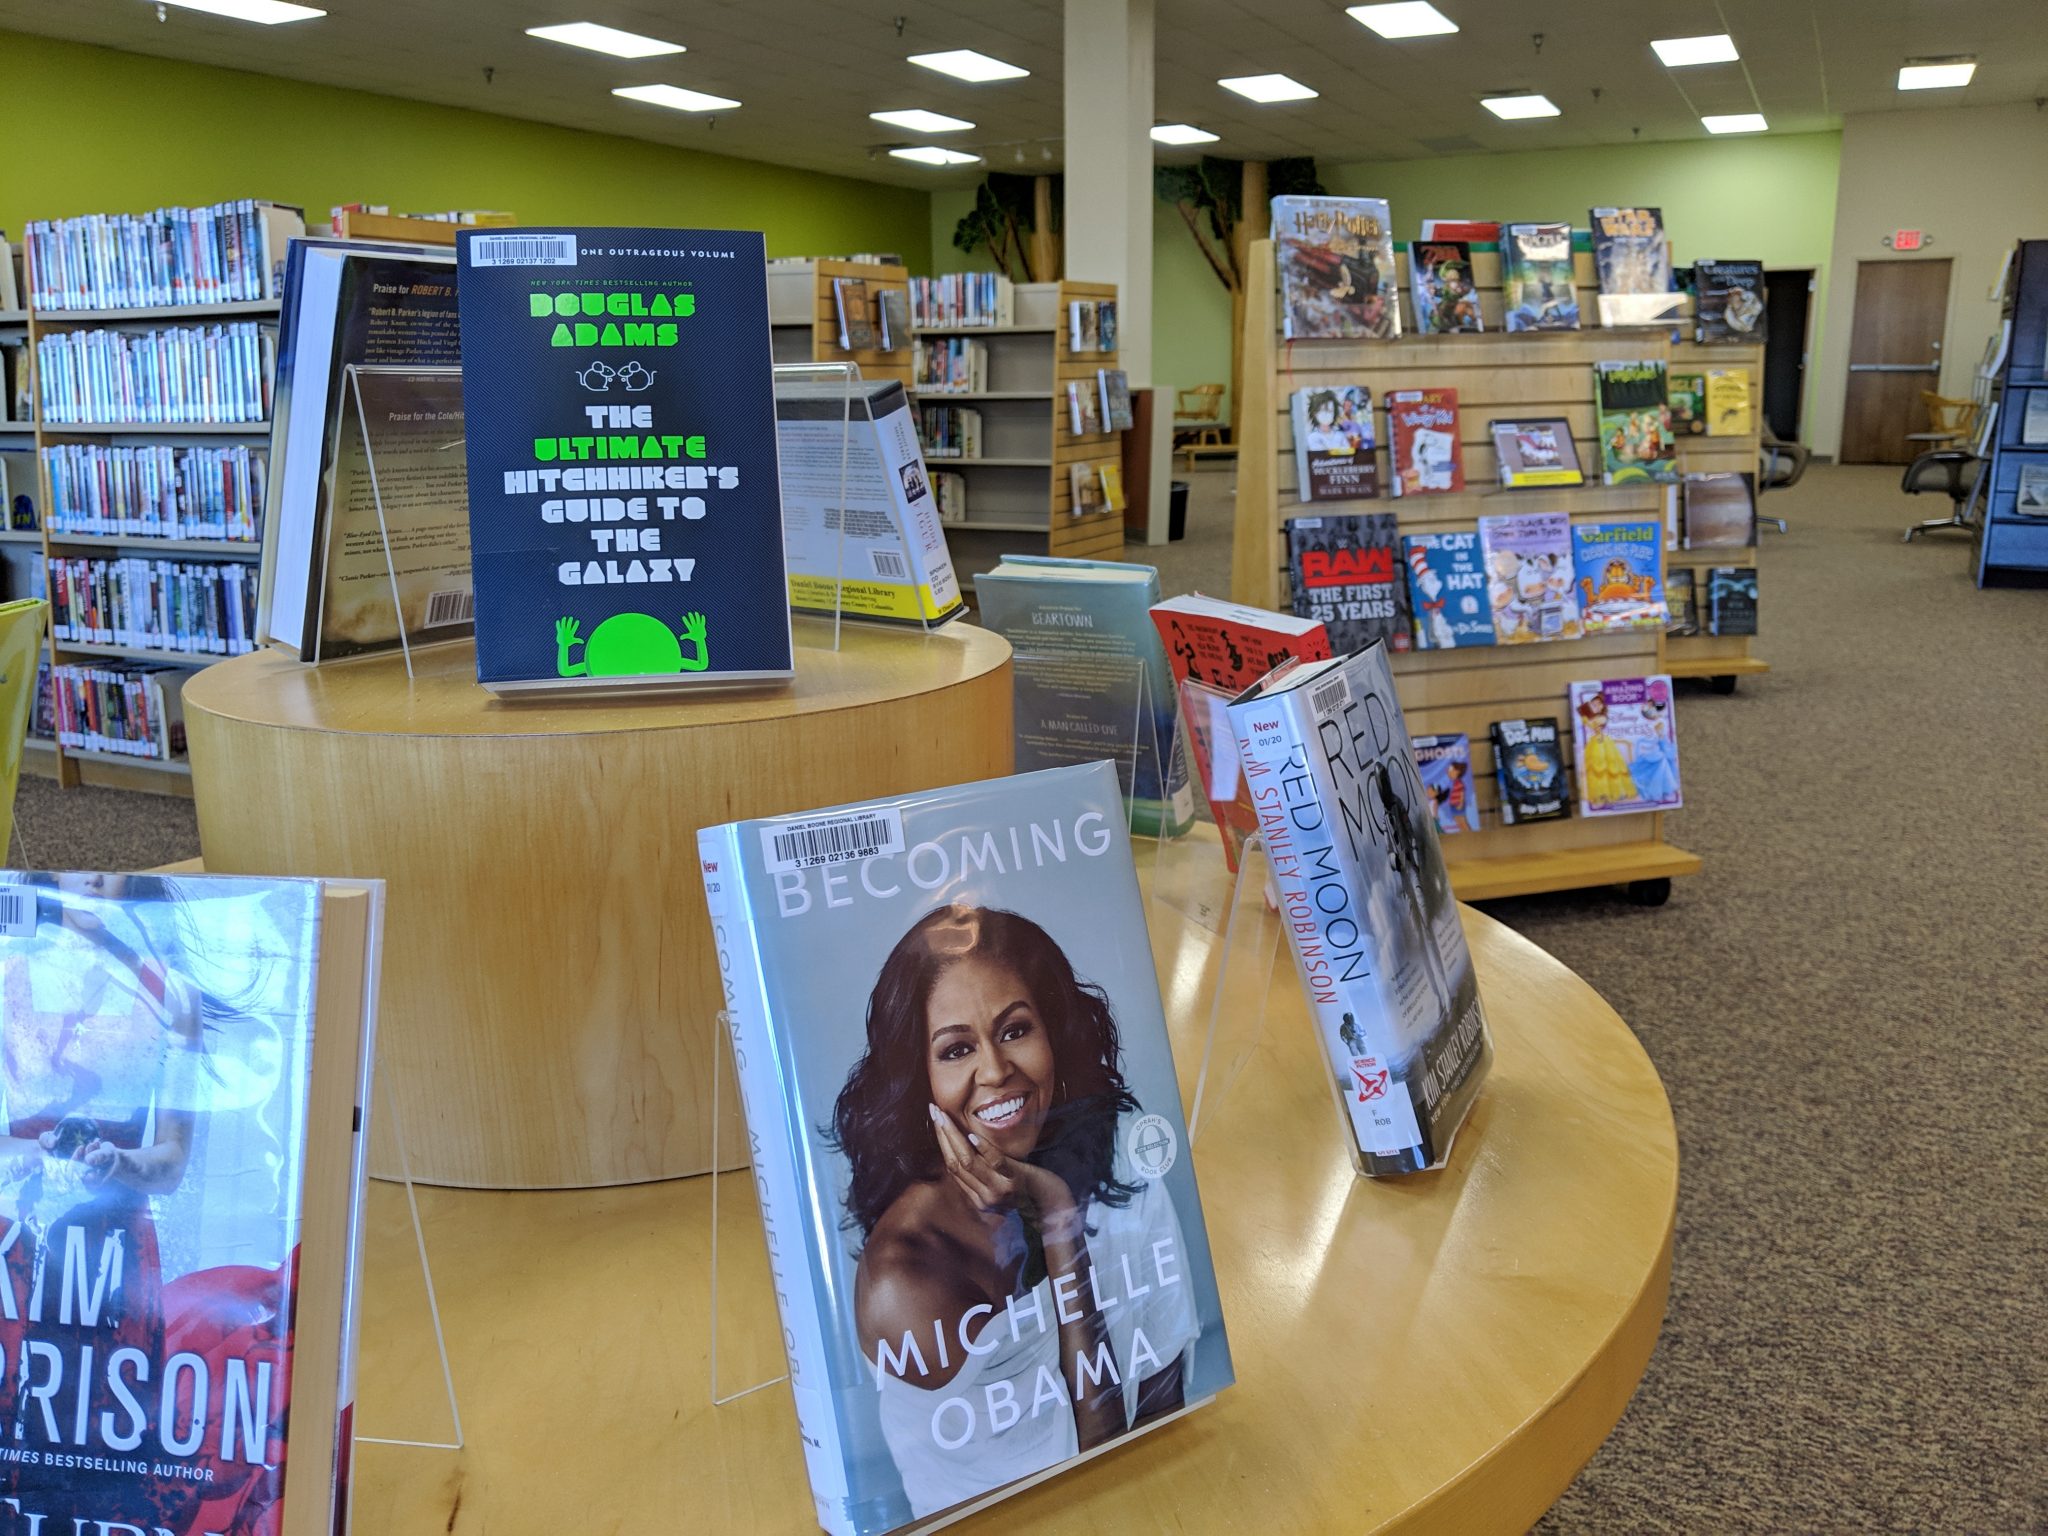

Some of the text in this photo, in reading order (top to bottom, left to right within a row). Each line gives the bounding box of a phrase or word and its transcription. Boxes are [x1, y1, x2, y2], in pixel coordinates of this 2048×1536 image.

[1294, 210, 1381, 237] Harry Potter
[581, 248, 735, 259] ONE OUTRAGEOUS VOLUME
[373, 283, 397, 294] Praise
[399, 284, 410, 294] for
[411, 285, 443, 296] ROBERT
[444, 286, 452, 296] B.
[529, 293, 696, 317] DOUGLAS
[551, 323, 679, 347] ADAMS
[389, 412, 411, 421] Praise
[413, 412, 423, 421] for
[424, 412, 436, 421] the
[585, 405, 653, 428] THE
[534, 436, 706, 461] ULTIMATE
[504, 466, 739, 494] HITCHHIKER'S
[1329, 474, 1360, 484] FINN
[541, 496, 706, 523] GUIDE TO
[591, 528, 661, 552] THE
[1441, 534, 1476, 551] CAT
[558, 558, 696, 585] GALAXY
[1302, 547, 1394, 580] RAW
[1452, 562, 1474, 572] THE
[790, 579, 812, 589] Daniel
[813, 581, 834, 591] Boone
[835, 583, 867, 596] egional
[868, 586, 896, 599] Library
[1446, 573, 1484, 590] HAT
[1309, 583, 1393, 604] THE FIRST
[1031, 612, 1094, 628] BEARTOWN
[1311, 600, 1395, 622] 25 YEARS
[1605, 684, 1644, 695] AMAZING
[1611, 694, 1637, 703] BOOK
[1048, 720, 1069, 732] MAN
[1069, 722, 1099, 734] CALLED
[1101, 724, 1118, 736] OVE
[1253, 719, 1279, 733] New
[1258, 735, 1282, 747] 01/20
[1318, 692, 1391, 790] RED
[787, 813, 876, 832] DANIEL BOONE REGIONAL LIBRARY
[703, 860, 718, 873] New
[772, 811, 1112, 918] BECOMING
[804, 856, 826, 866] 1269
[828, 851, 856, 862] 02136
[857, 846, 880, 857] 9883
[1279, 743, 1371, 982] RED MOON
[1255, 787, 1302, 884] STANLEY
[1284, 892, 1339, 1004] ROBINSON
[715, 924, 748, 1073] COMING
[1421, 1068, 1441, 1111] KIM
[1436, 1028, 1464, 1091] STANLEY
[1136, 1116, 1162, 1131] OPRAH'S
[1375, 1117, 1392, 1127] ROB
[1140, 1156, 1172, 1175] BOOK CLUB
[875, 1236, 1180, 1392] MICHELLE
[931, 1326, 1162, 1450] OBAMA
[0, 1341, 272, 1465] RISON
[44, 1452, 148, 1475] BESTSELLING
[153, 1464, 214, 1482] AUTHOR
